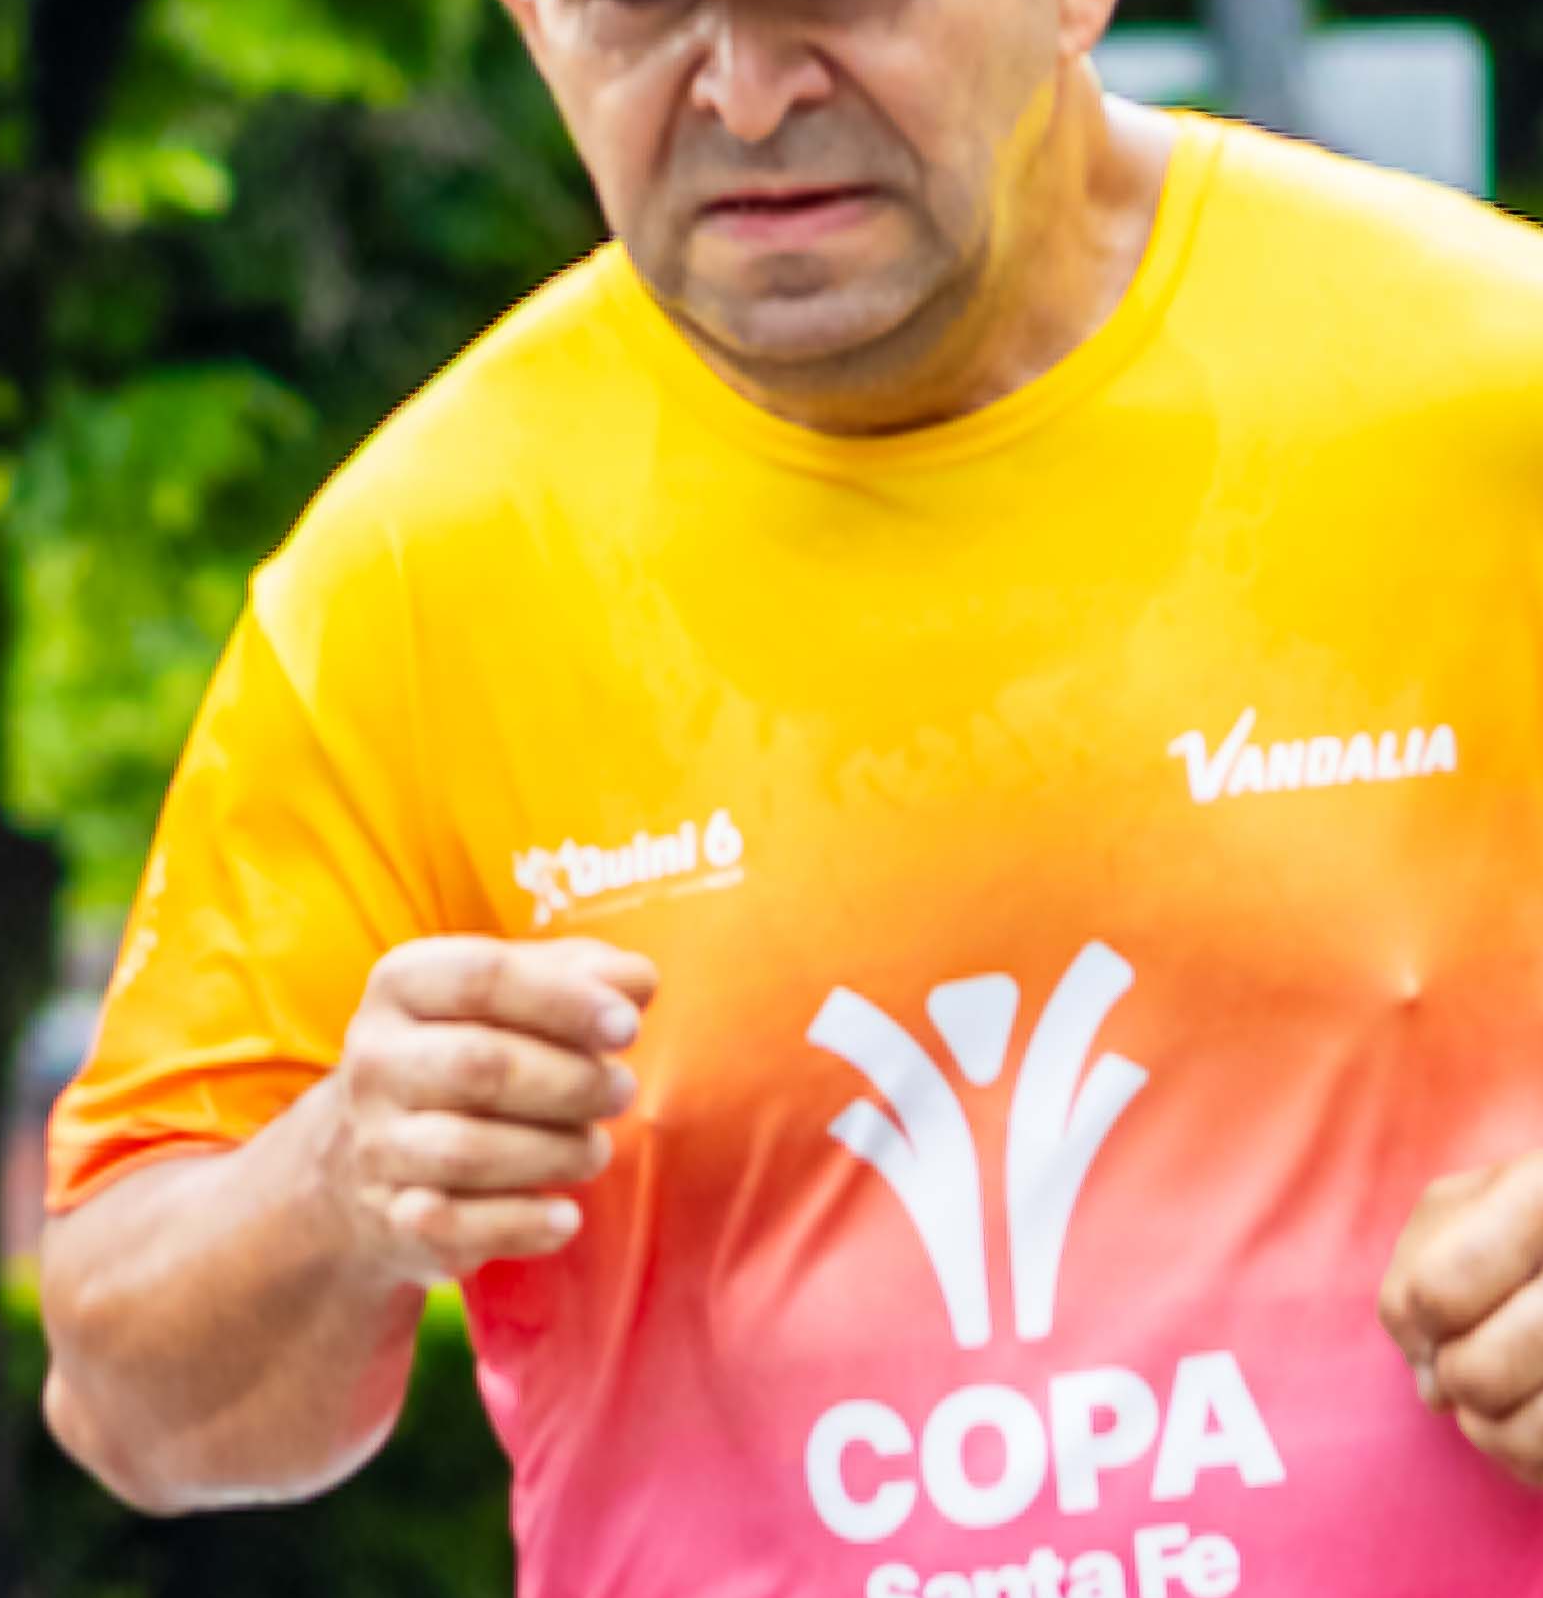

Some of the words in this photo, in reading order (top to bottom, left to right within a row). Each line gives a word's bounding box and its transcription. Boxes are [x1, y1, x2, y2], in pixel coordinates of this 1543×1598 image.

[1167, 706, 1456, 804] VANDALIA
[704, 807, 743, 867] 6
[805, 1350, 1286, 1544] COPA
